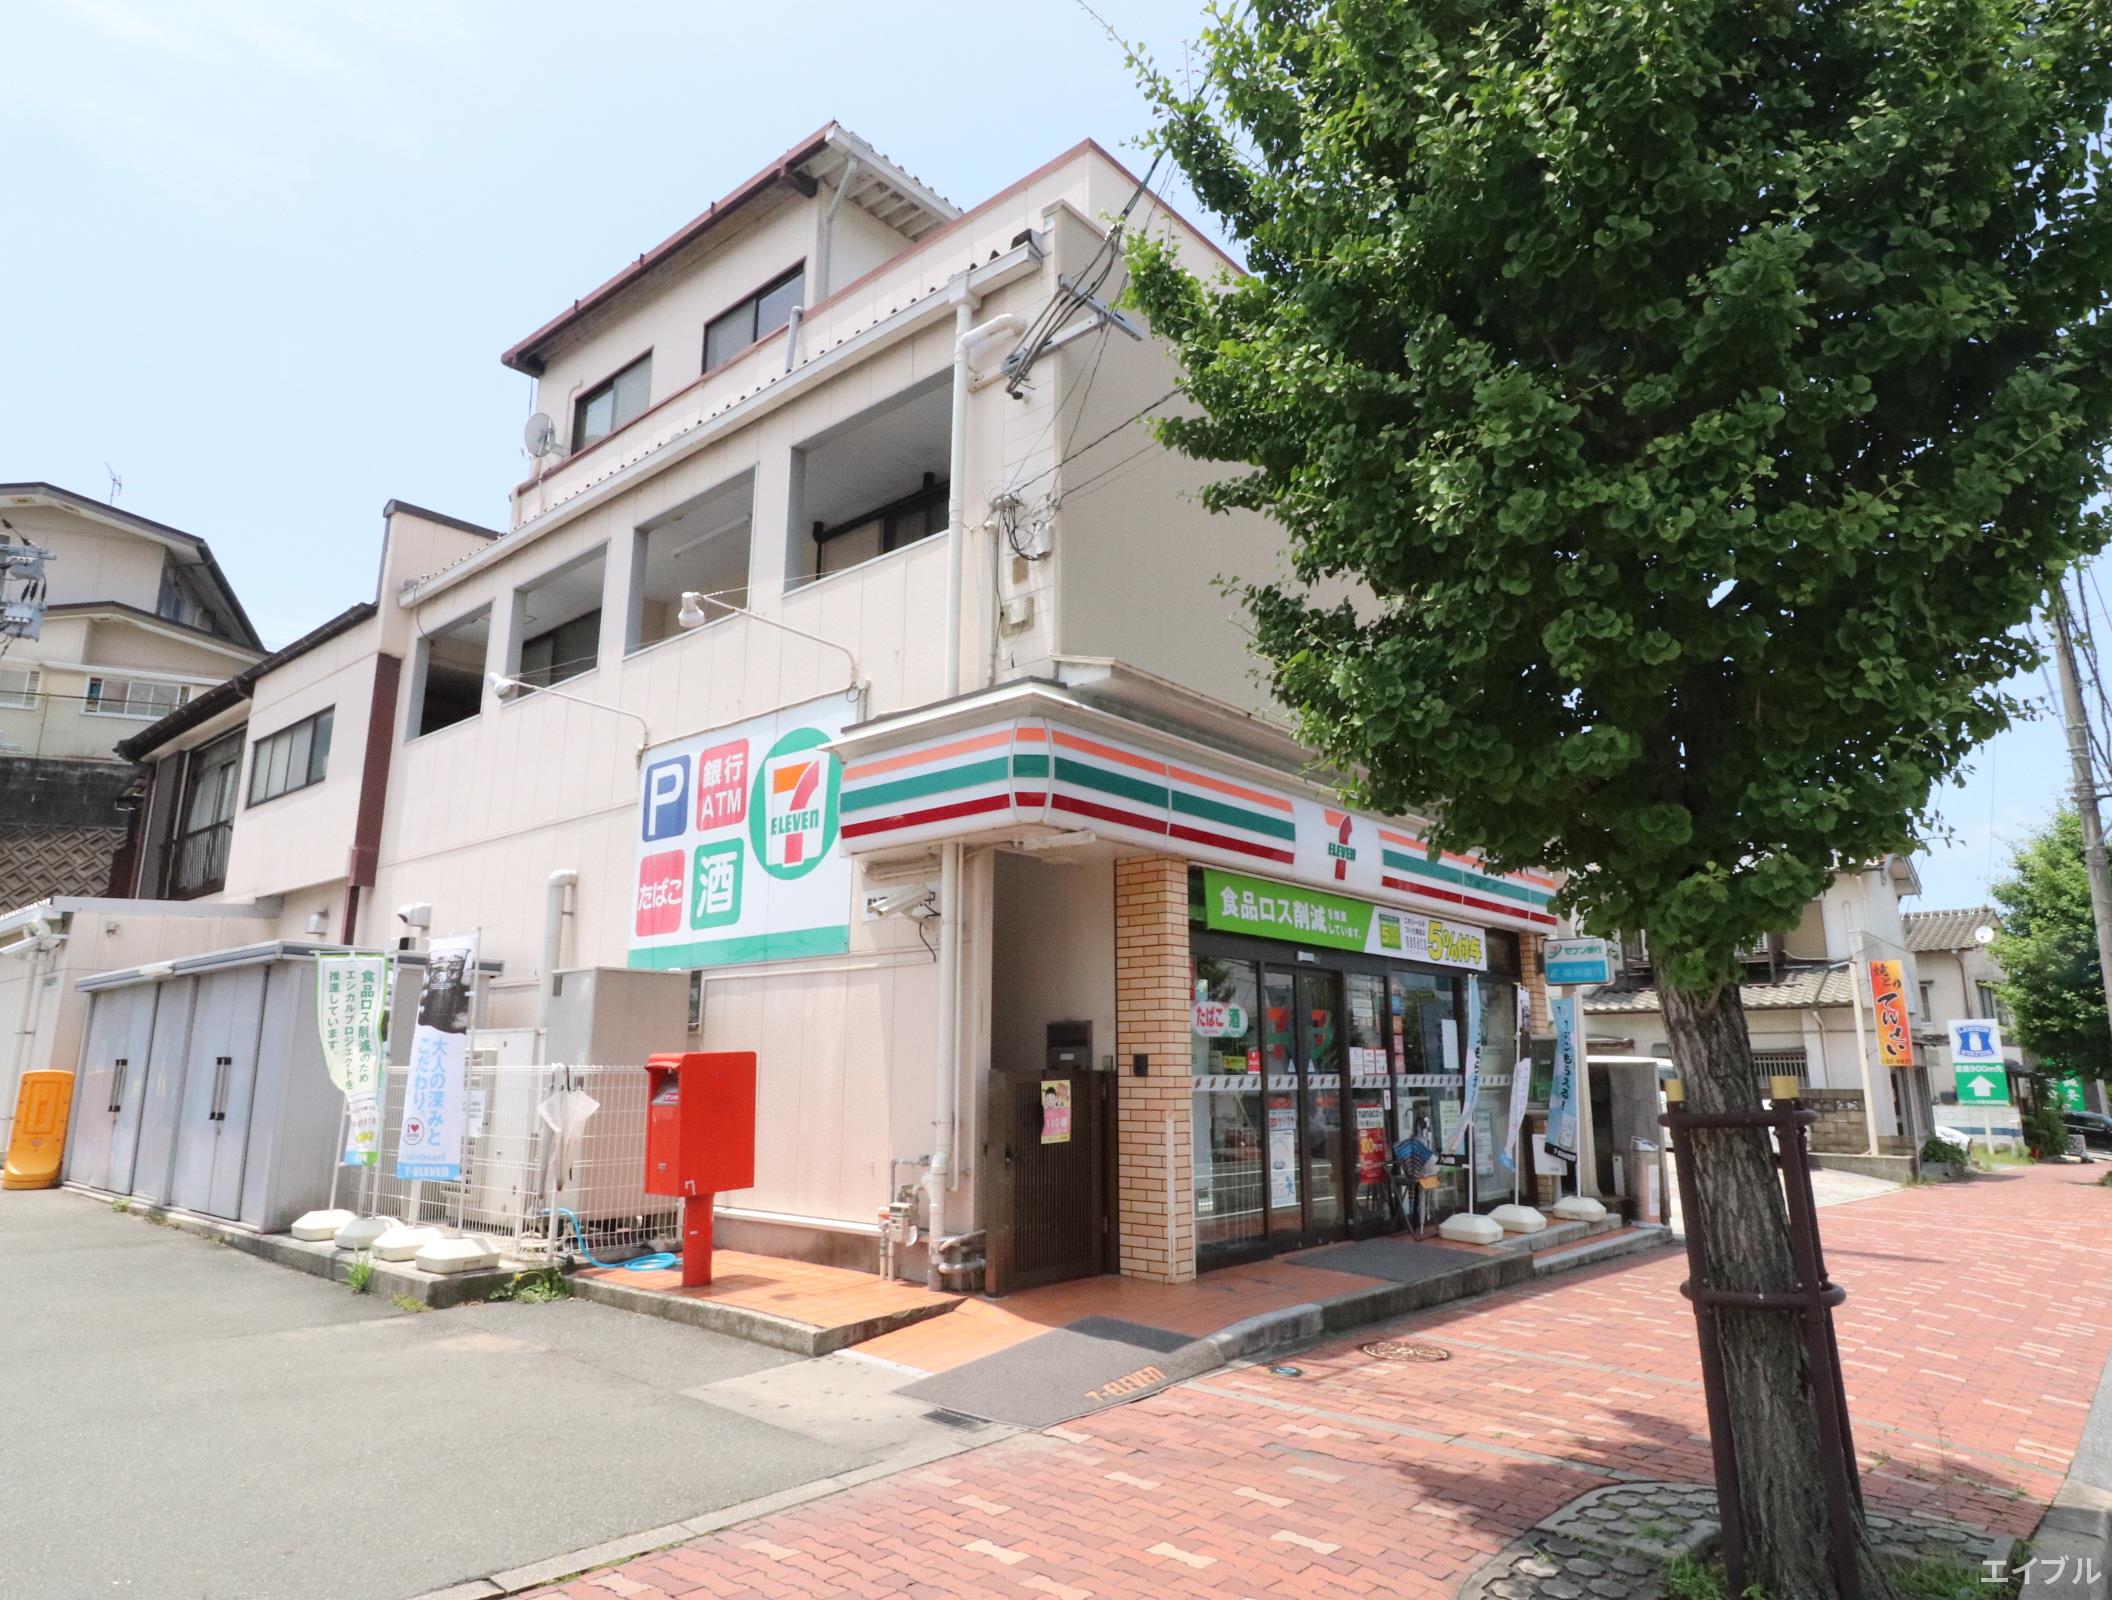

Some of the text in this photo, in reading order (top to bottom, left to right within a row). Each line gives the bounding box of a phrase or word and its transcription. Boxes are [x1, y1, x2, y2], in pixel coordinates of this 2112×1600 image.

[703, 753, 744, 788] 銀行
[648, 763, 685, 837] P
[701, 788, 742, 822] ATM
[770, 809, 819, 836] ELEVEN
[1328, 842, 1356, 861] ELEVEN
[638, 877, 682, 912] たばこ
[696, 852, 738, 919] 酒
[1220, 886, 1328, 933] 食品ロス削減
[344, 970, 357, 1090] エシカルプロジェクトを
[358, 969, 375, 1083] 食品ロス削減のため
[1196, 1006, 1224, 1028] たばこ
[1228, 1008, 1240, 1029] 酒
[428, 1037, 448, 1146] 大人の深みと
